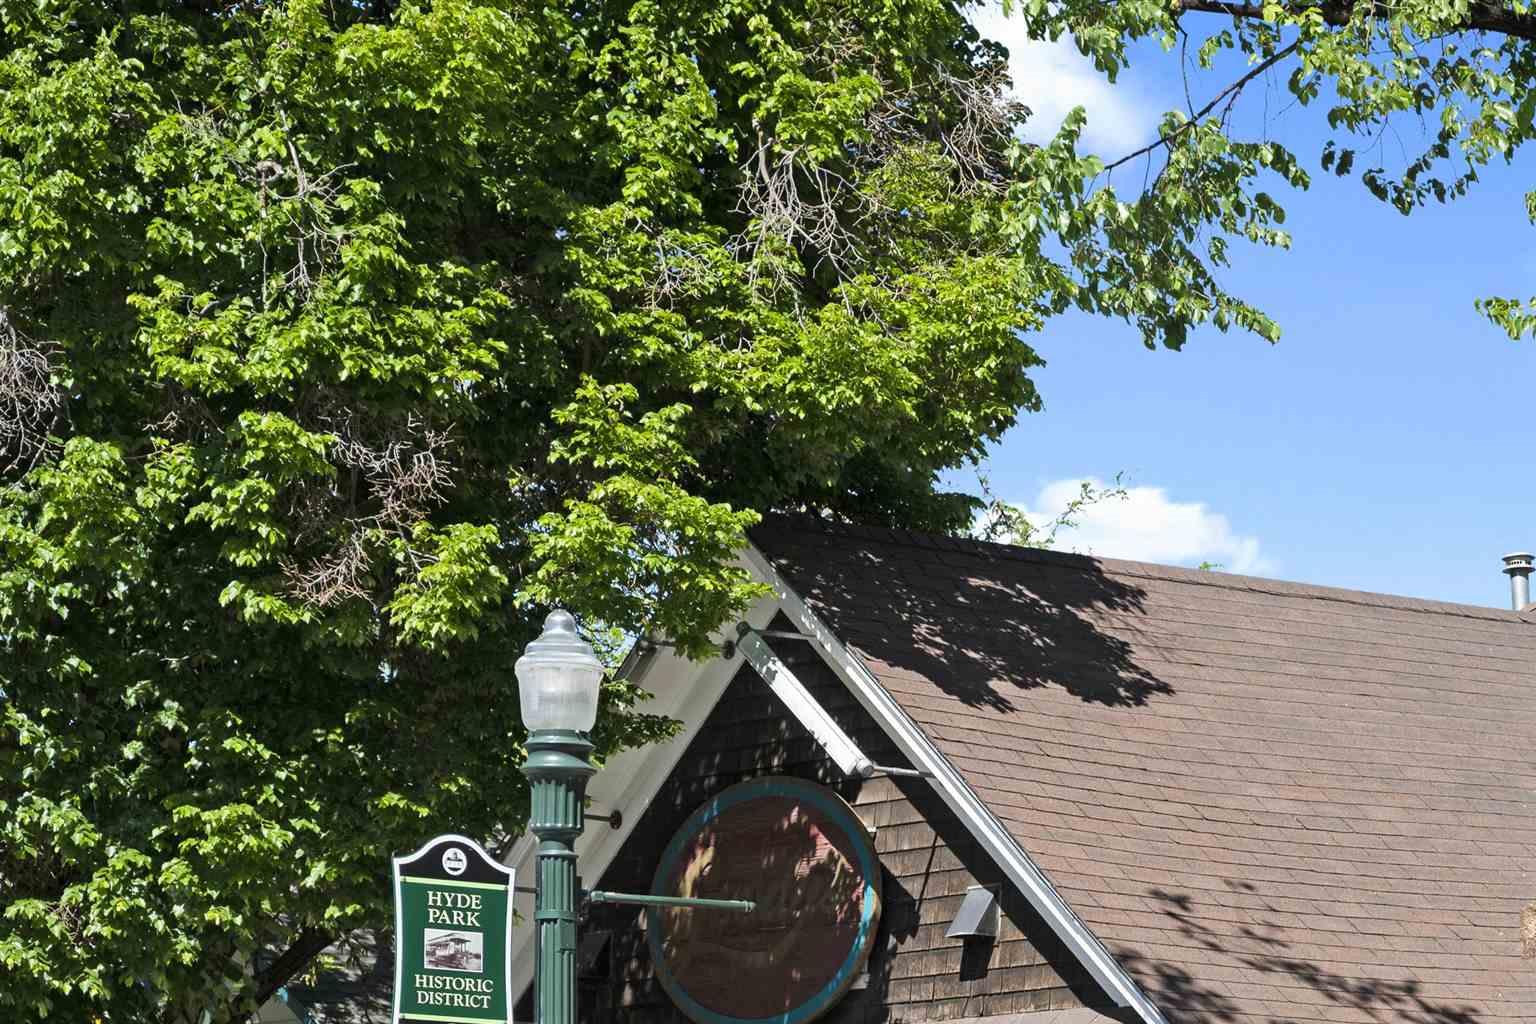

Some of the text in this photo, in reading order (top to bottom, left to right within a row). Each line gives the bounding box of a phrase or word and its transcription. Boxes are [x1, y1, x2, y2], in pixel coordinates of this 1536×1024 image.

[426, 890, 483, 910] HYDE
[428, 908, 481, 927] PARK
[414, 974, 494, 993] HISTORIC
[416, 990, 492, 1009] DISTRICT
